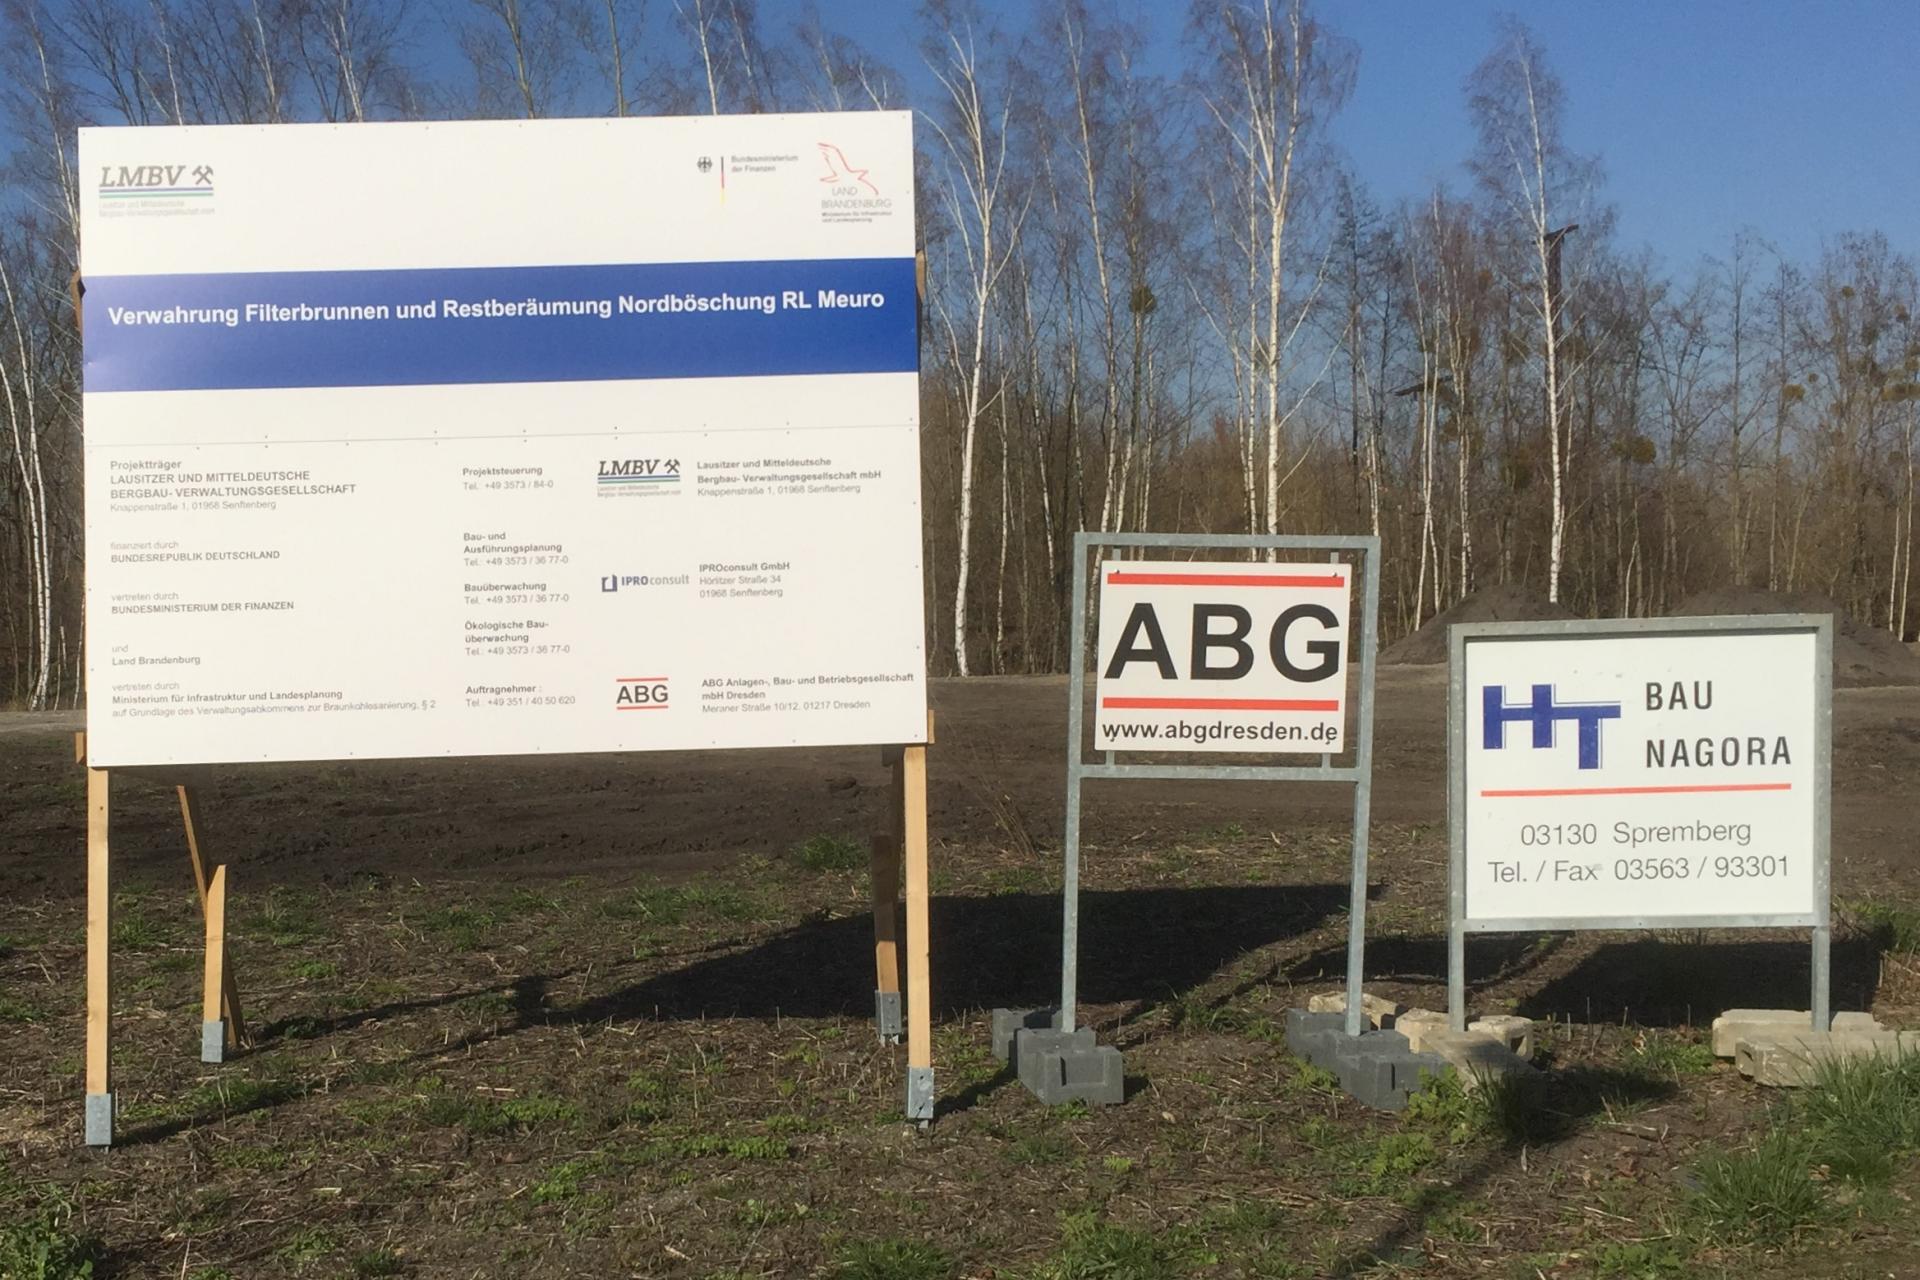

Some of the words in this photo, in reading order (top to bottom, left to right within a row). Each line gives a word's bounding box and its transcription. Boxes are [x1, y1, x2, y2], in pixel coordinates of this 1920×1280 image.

[99, 165, 185, 187] LMBV
[832, 187, 858, 196] LAND
[821, 198, 892, 209] BRANDENBURG
[108, 306, 238, 327] Verwahrung
[245, 303, 389, 322] Filterbrunnen
[396, 301, 436, 319] und
[444, 298, 611, 319] Restberäumung
[619, 293, 775, 314] Nordböschung
[782, 291, 811, 308] RL
[818, 290, 885, 308] Meuro
[110, 460, 181, 471] Projektträger
[598, 459, 660, 476] LMBV
[697, 460, 740, 469] Lausitzer
[743, 460, 760, 468] und
[763, 458, 831, 467] Mitteldeutsche
[462, 466, 543, 477] Projektsteuerung
[110, 474, 174, 485] LAUSITZER
[178, 473, 203, 483] UND
[206, 471, 310, 482] MITTELDEUTSCHE
[698, 474, 740, 485] Bergbau-
[742, 472, 857, 484] Verwaltungsgesellschaft
[860, 470, 881, 479] mbH
[485, 481, 501, 489] +49
[807, 484, 861, 494] Senftenberg
[110, 488, 173, 499] BERGBAU-
[175, 484, 356, 498] VERWALTUNGSGESELLSCHAFT
[110, 502, 178, 513] Knappenstraße
[222, 499, 276, 511] Senftenberg
[464, 532, 486, 541] Bau-
[488, 532, 506, 540] und
[154, 541, 179, 549] durch
[464, 544, 562, 554] Ausführungsplanung
[111, 552, 202, 563] BUNDESREPUBLIK
[205, 551, 280, 561] DEUTSCHLAND
[486, 557, 502, 566] +49
[699, 563, 758, 572] IPROconsult
[760, 562, 790, 571] GmbH
[621, 574, 690, 586] IPROconsult
[739, 575, 767, 584] Straße
[770, 575, 781, 583] 34
[464, 582, 546, 592] Bauüberwachung
[730, 588, 783, 598] Senftenberg
[487, 595, 503, 604] +49
[112, 603, 218, 614] BUNDESMINISTERIUM
[221, 603, 241, 611] DER
[245, 601, 294, 610] FINANZEN
[465, 620, 524, 631] Ökologische
[526, 620, 549, 628] Bau-
[465, 634, 529, 643] überwachung
[1104, 602, 1340, 683] ABG
[112, 645, 128, 653] und
[488, 647, 504, 655] +49
[112, 657, 135, 666] Land
[138, 656, 200, 666] Brandenburg
[702, 679, 724, 687] ABG
[773, 677, 795, 685] Bau-
[798, 676, 816, 685] und
[818, 674, 914, 684] Betriebsgesellschaft
[466, 685, 536, 695] Auftragnehmer
[616, 684, 669, 704] ABG
[702, 692, 724, 700] mbH
[726, 691, 766, 700] Dresden
[1646, 680, 1713, 711] BAU
[112, 694, 167, 704] Ministerium
[171, 694, 185, 703] für
[187, 692, 246, 702] Infrastruktur
[249, 691, 267, 700] und
[270, 690, 343, 702] Landesplanung
[488, 698, 504, 706] +49
[507, 697, 523, 706] 351
[531, 696, 543, 705] 40
[545, 696, 556, 704] 50
[559, 696, 576, 704] 620
[178, 707, 194, 716] des
[308, 703, 320, 712] zur
[430, 699, 436, 708] 2
[741, 703, 771, 712] Straße
[804, 701, 831, 710] 01217
[833, 701, 871, 709] Dresden
[1102, 720, 1338, 743] www.abgdresden.de
[1483, 684, 1621, 769] HT
[1646, 736, 1792, 768] NAGORA
[1520, 823, 1597, 846] 03130
[1613, 820, 1751, 848] Spremberg
[1488, 861, 1527, 883] Tel.
[1536, 860, 1545, 881] /
[1554, 860, 1599, 881] Fax
[1614, 858, 1690, 880] 03563
[1697, 857, 1708, 878] /
[1714, 855, 1789, 878] 93301
